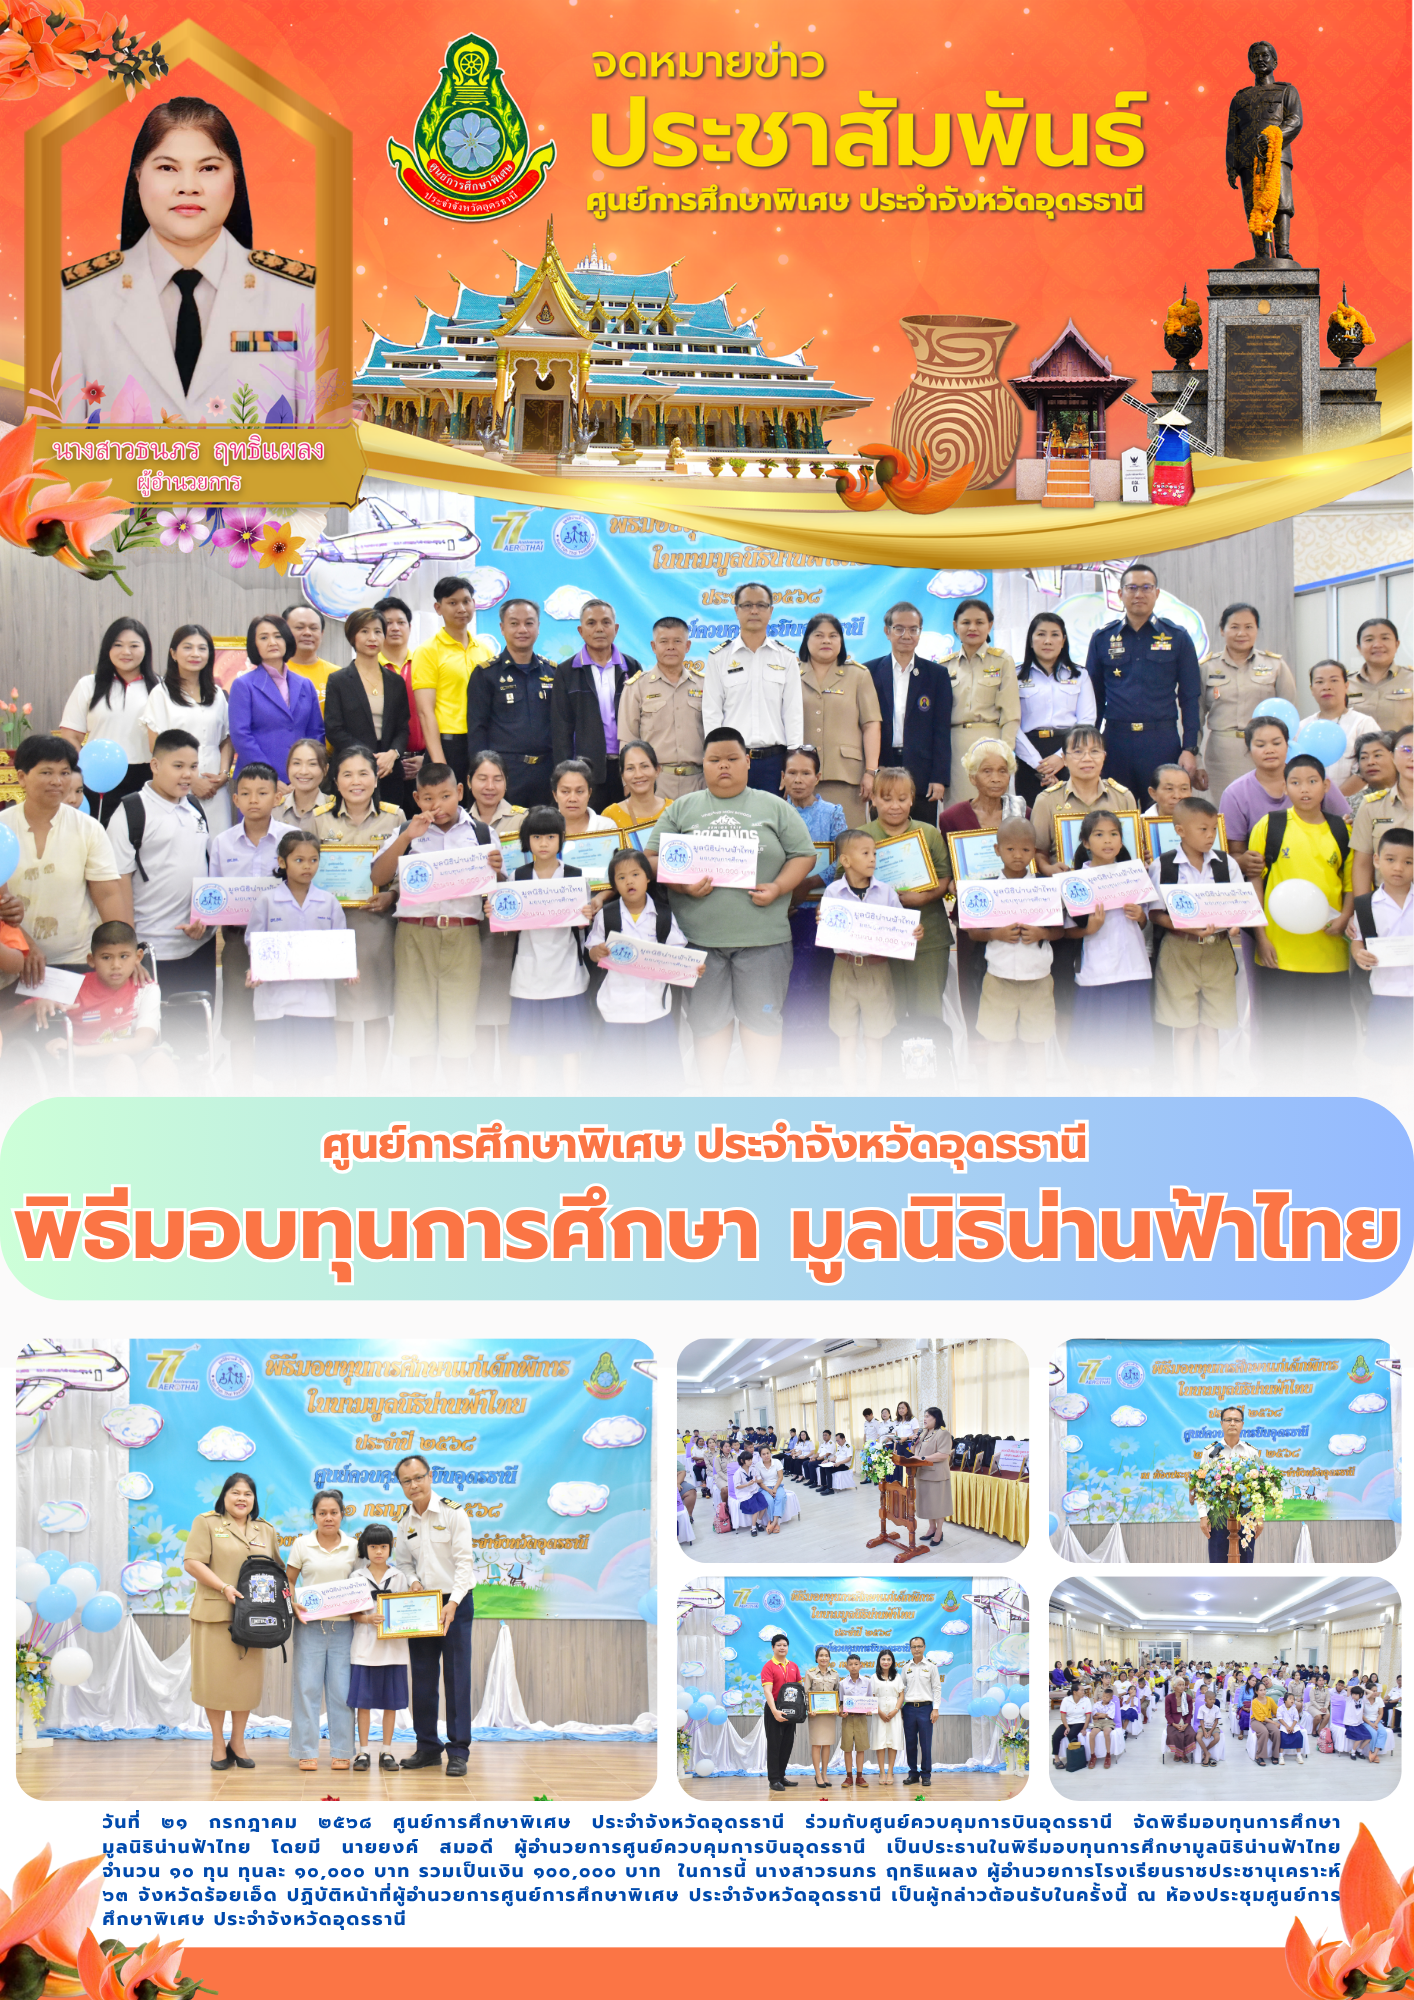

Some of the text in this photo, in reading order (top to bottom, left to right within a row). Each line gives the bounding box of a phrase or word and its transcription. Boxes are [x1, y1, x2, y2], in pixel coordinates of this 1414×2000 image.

[492, 511, 530, 549] 77
[432, 853, 488, 870] มูลนิธิน่านฟ้าไท
[147, 1350, 186, 1388] 77
[265, 1353, 572, 1386] พิธีมอบทุนการศึกษาแก่เด็กพิการ
[307, 1388, 528, 1422] ในนามมูลนิธิน่านฟ้าไทย
[355, 1430, 477, 1451] ประจำปี ๒๕๖๘
